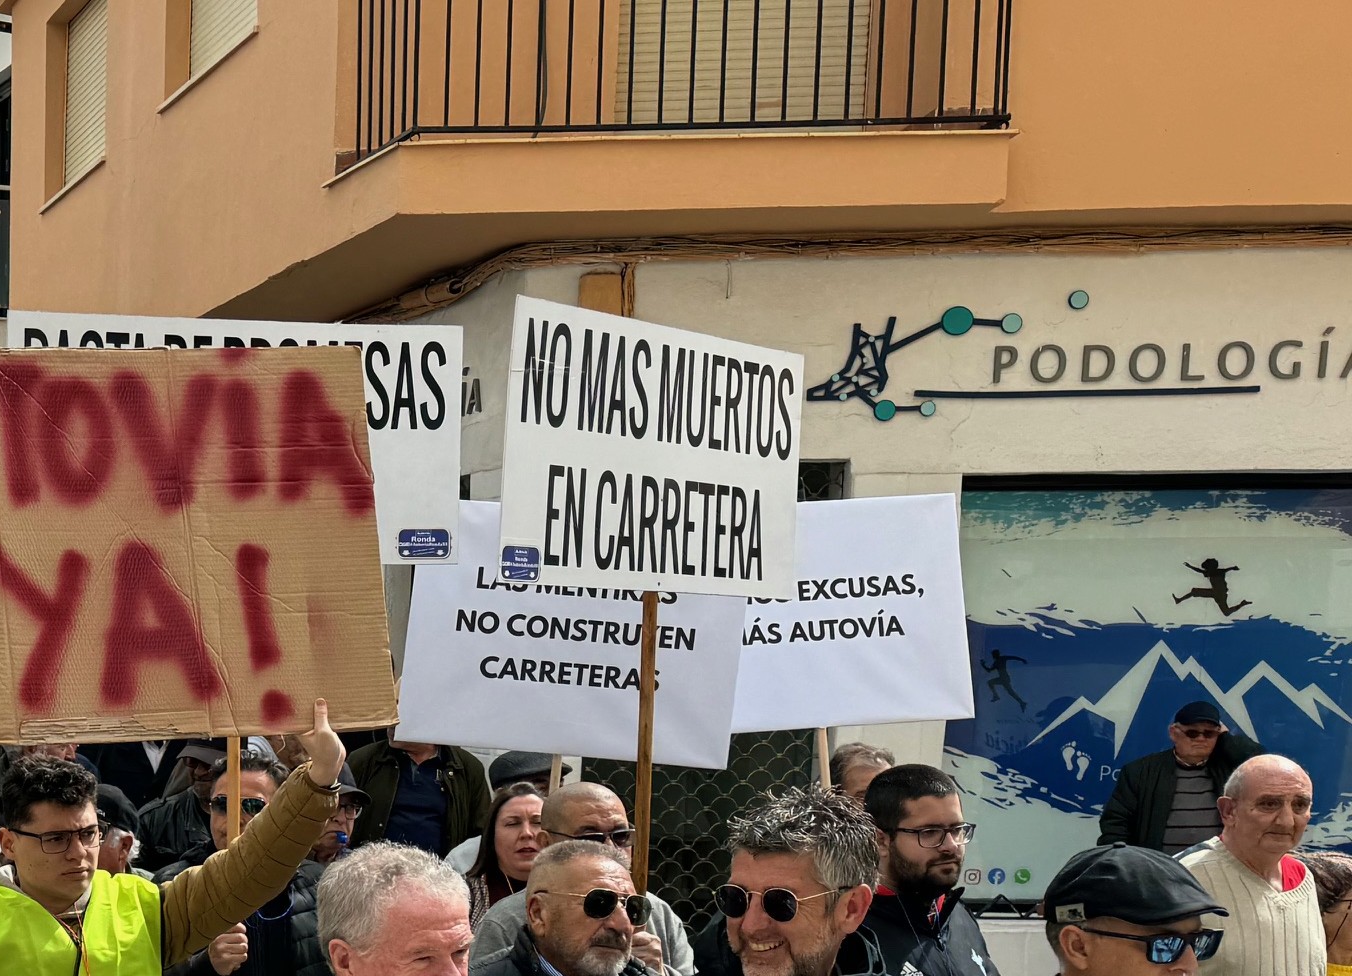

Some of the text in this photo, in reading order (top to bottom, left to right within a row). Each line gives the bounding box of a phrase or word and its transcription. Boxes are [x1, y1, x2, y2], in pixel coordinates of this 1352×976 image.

[520, 317, 572, 428] NO
[577, 328, 652, 440] MAS
[657, 344, 795, 461] MUERTOS
[544, 464, 763, 581] EN CARRETERA
[797, 573, 924, 601] EXCUSAS,
[456, 609, 696, 651] NO CONSTRUEN
[789, 608, 906, 643] AUTOVÍA
